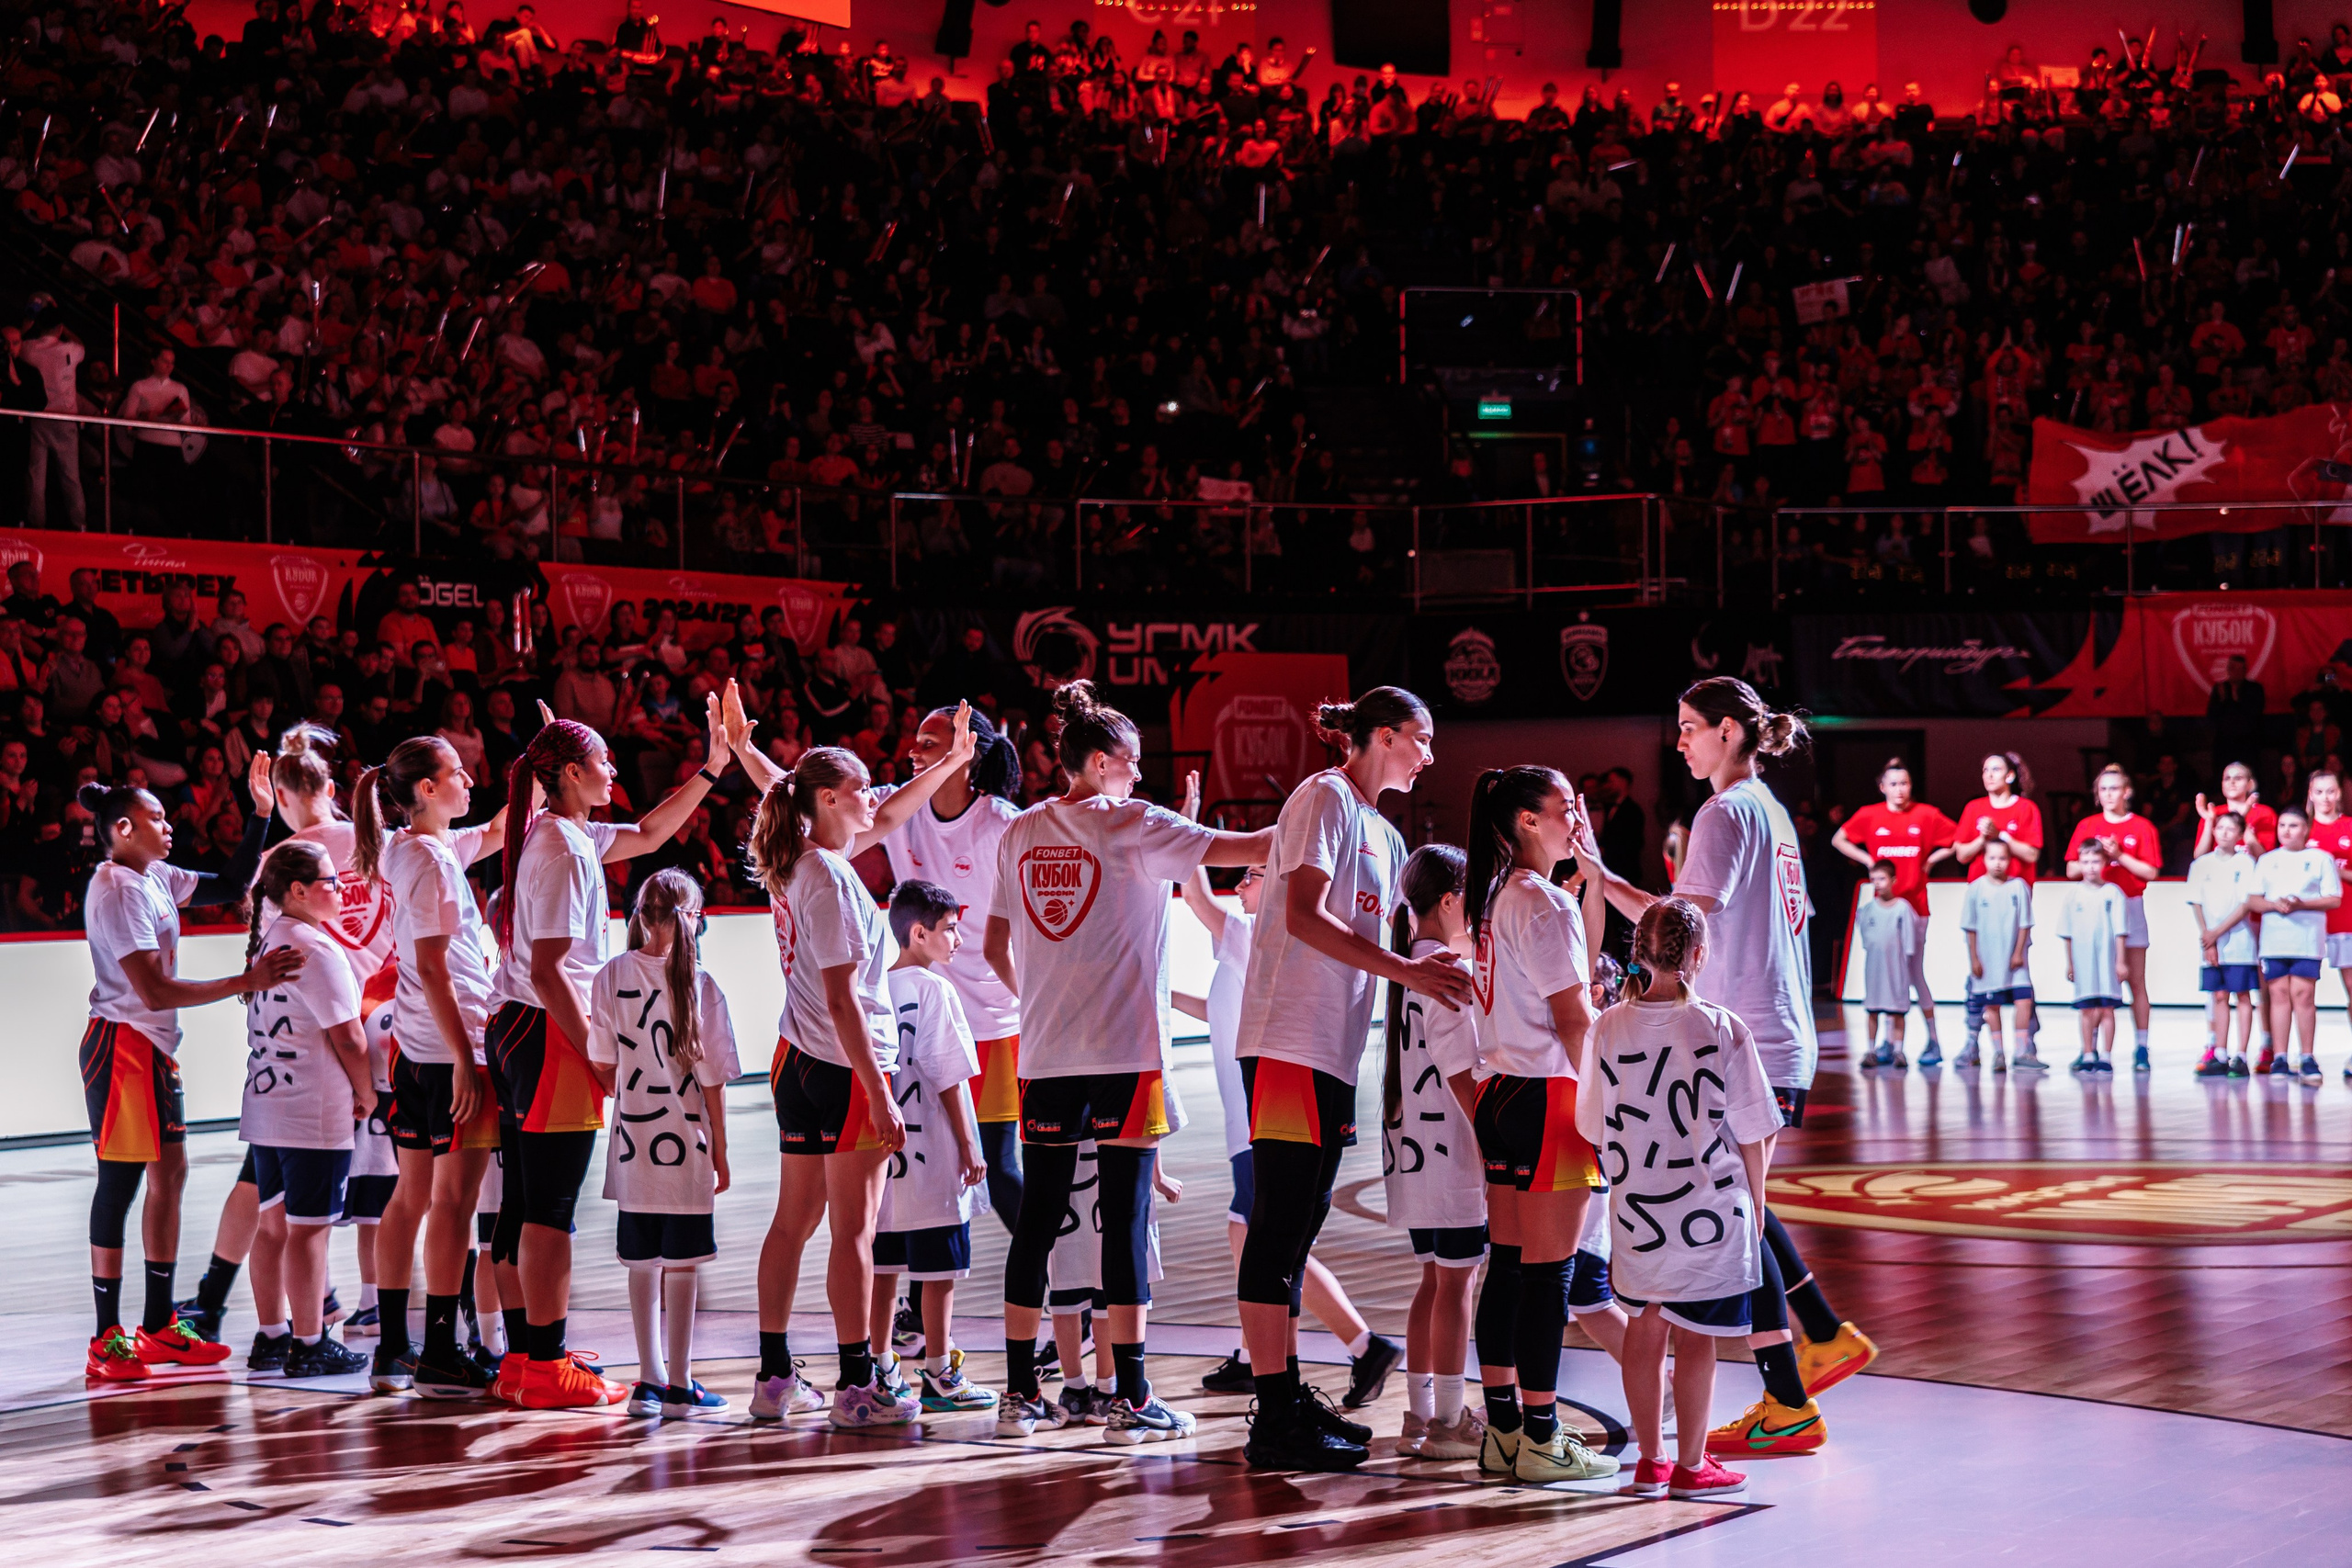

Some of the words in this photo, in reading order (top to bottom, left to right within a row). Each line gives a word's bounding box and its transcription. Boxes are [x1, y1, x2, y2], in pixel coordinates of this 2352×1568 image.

[2089, 428, 2204, 520] ЩЁЛК!
[1106, 622, 1261, 654] УГМК
[2192, 619, 2255, 646] КУБОК
[1035, 848, 1080, 859] FONBET
[1031, 863, 1082, 888] КУБОК
